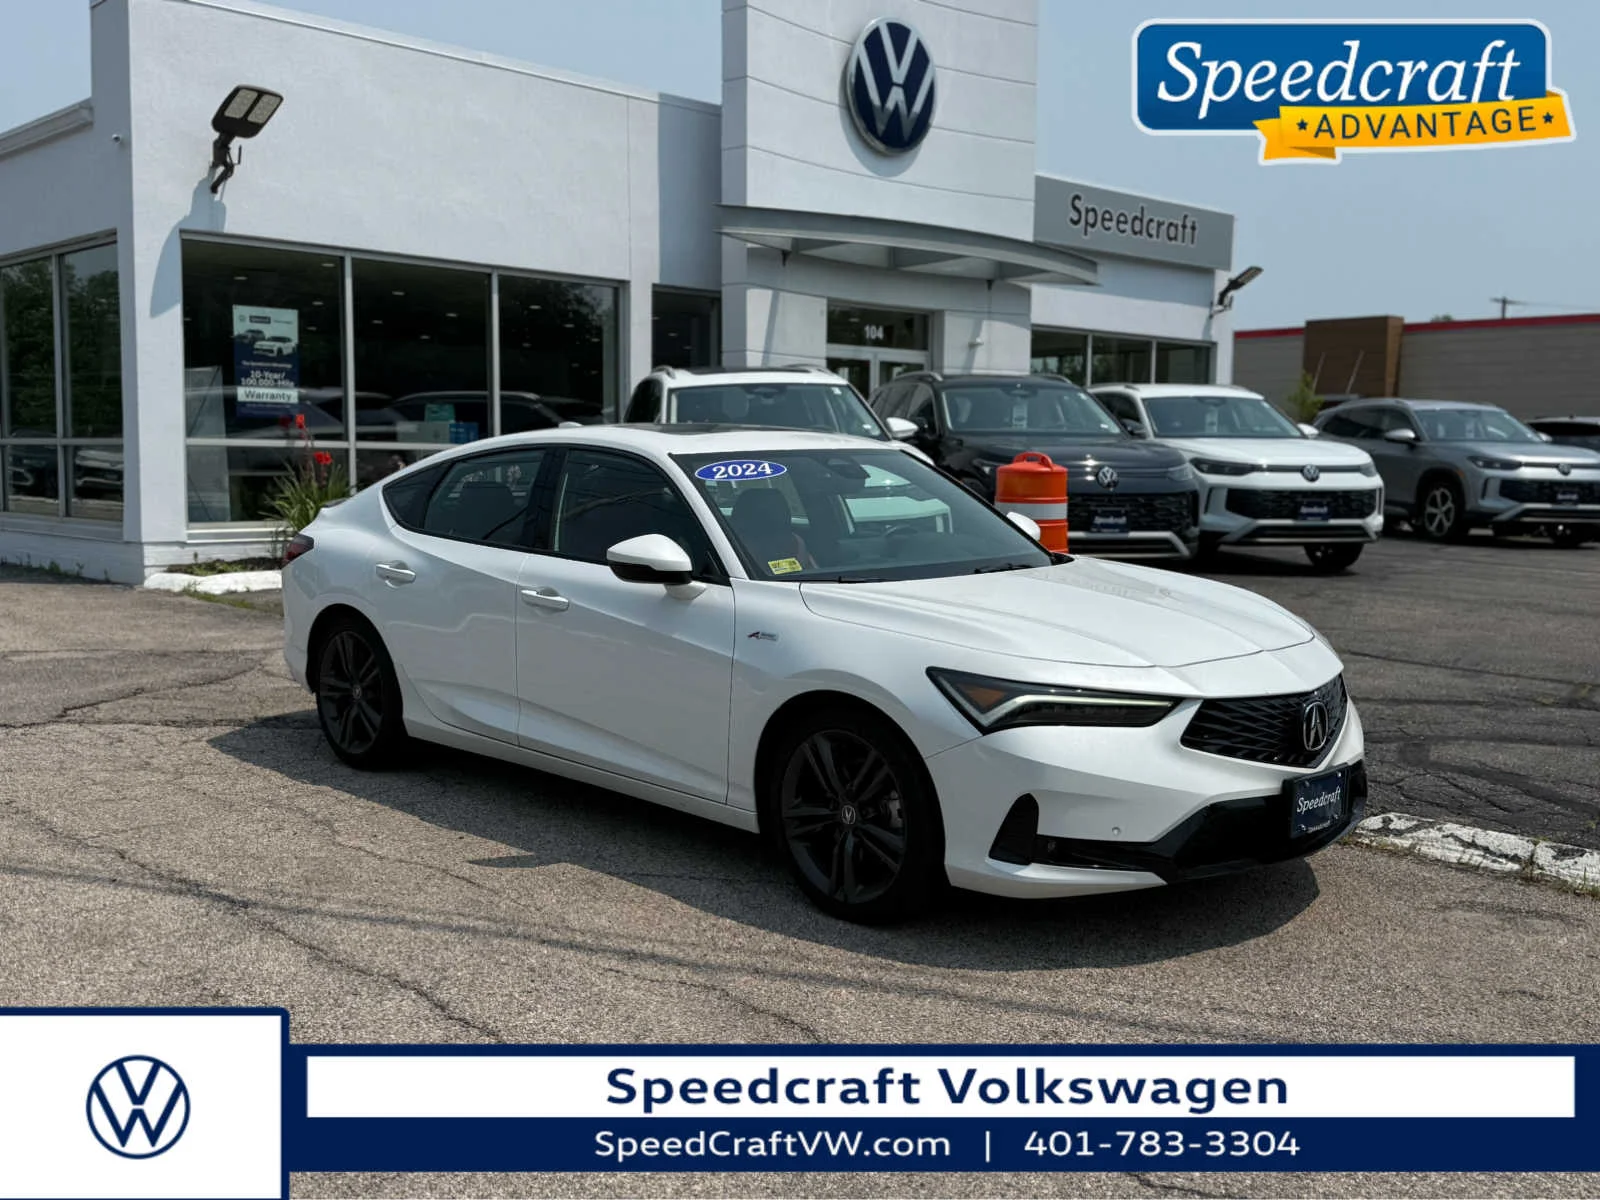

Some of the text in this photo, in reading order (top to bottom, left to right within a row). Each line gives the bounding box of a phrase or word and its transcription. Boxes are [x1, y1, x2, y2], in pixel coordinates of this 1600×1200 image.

[1069, 194, 1197, 245] Speedcraft
[864, 324, 884, 340] 104
[244, 389, 292, 402] Warranty
[712, 462, 774, 479] 2024
[1296, 785, 1341, 815] Speedcraft
